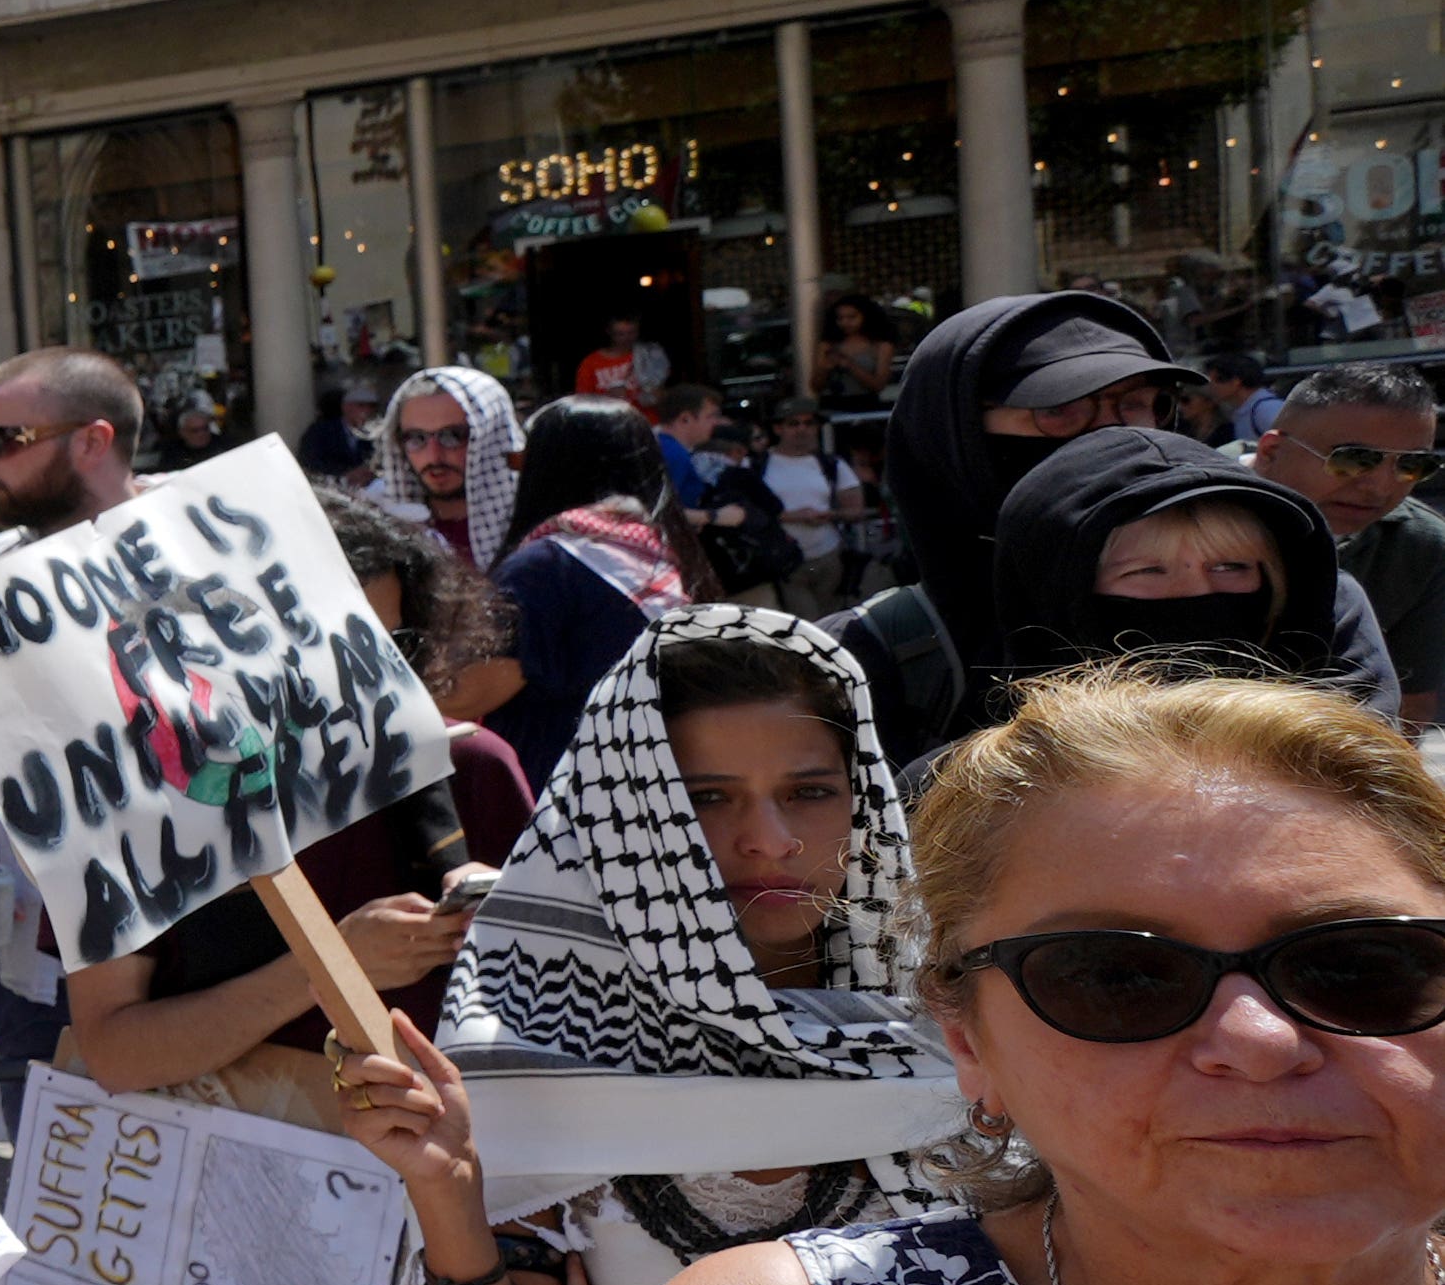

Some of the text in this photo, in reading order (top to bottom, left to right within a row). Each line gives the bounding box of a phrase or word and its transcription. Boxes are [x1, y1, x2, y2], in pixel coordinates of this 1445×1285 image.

[499, 143, 659, 204] SOHO
[48, 520, 172, 629] ONE
[187, 496, 272, 558] IS
[106, 563, 323, 702] FREE
[78, 691, 414, 963] ALL FREE
[25, 1101, 97, 1267] SUFFRA
